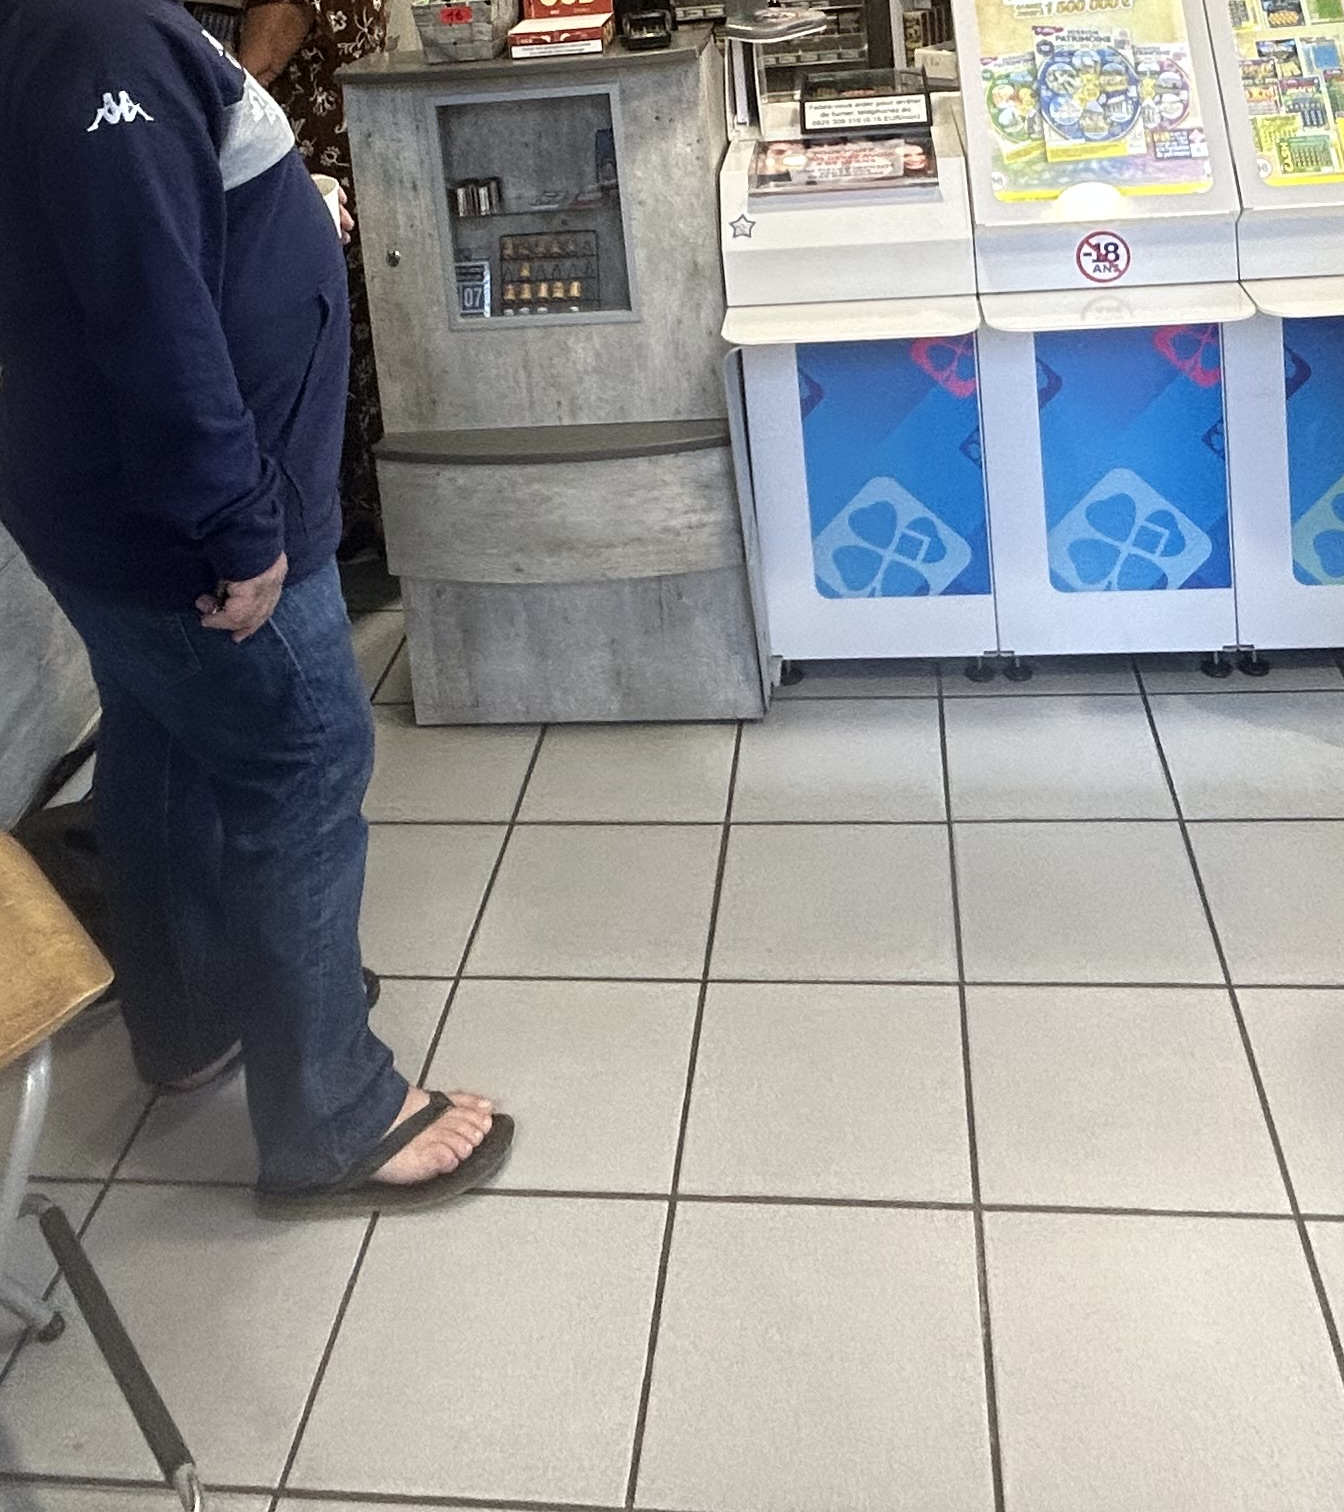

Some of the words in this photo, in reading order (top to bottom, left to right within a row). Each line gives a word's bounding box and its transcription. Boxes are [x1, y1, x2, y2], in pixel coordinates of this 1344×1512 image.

[1083, 241, 1120, 264] -18
[1092, 264, 1121, 274] ANS
[464, 287, 483, 307] 07
